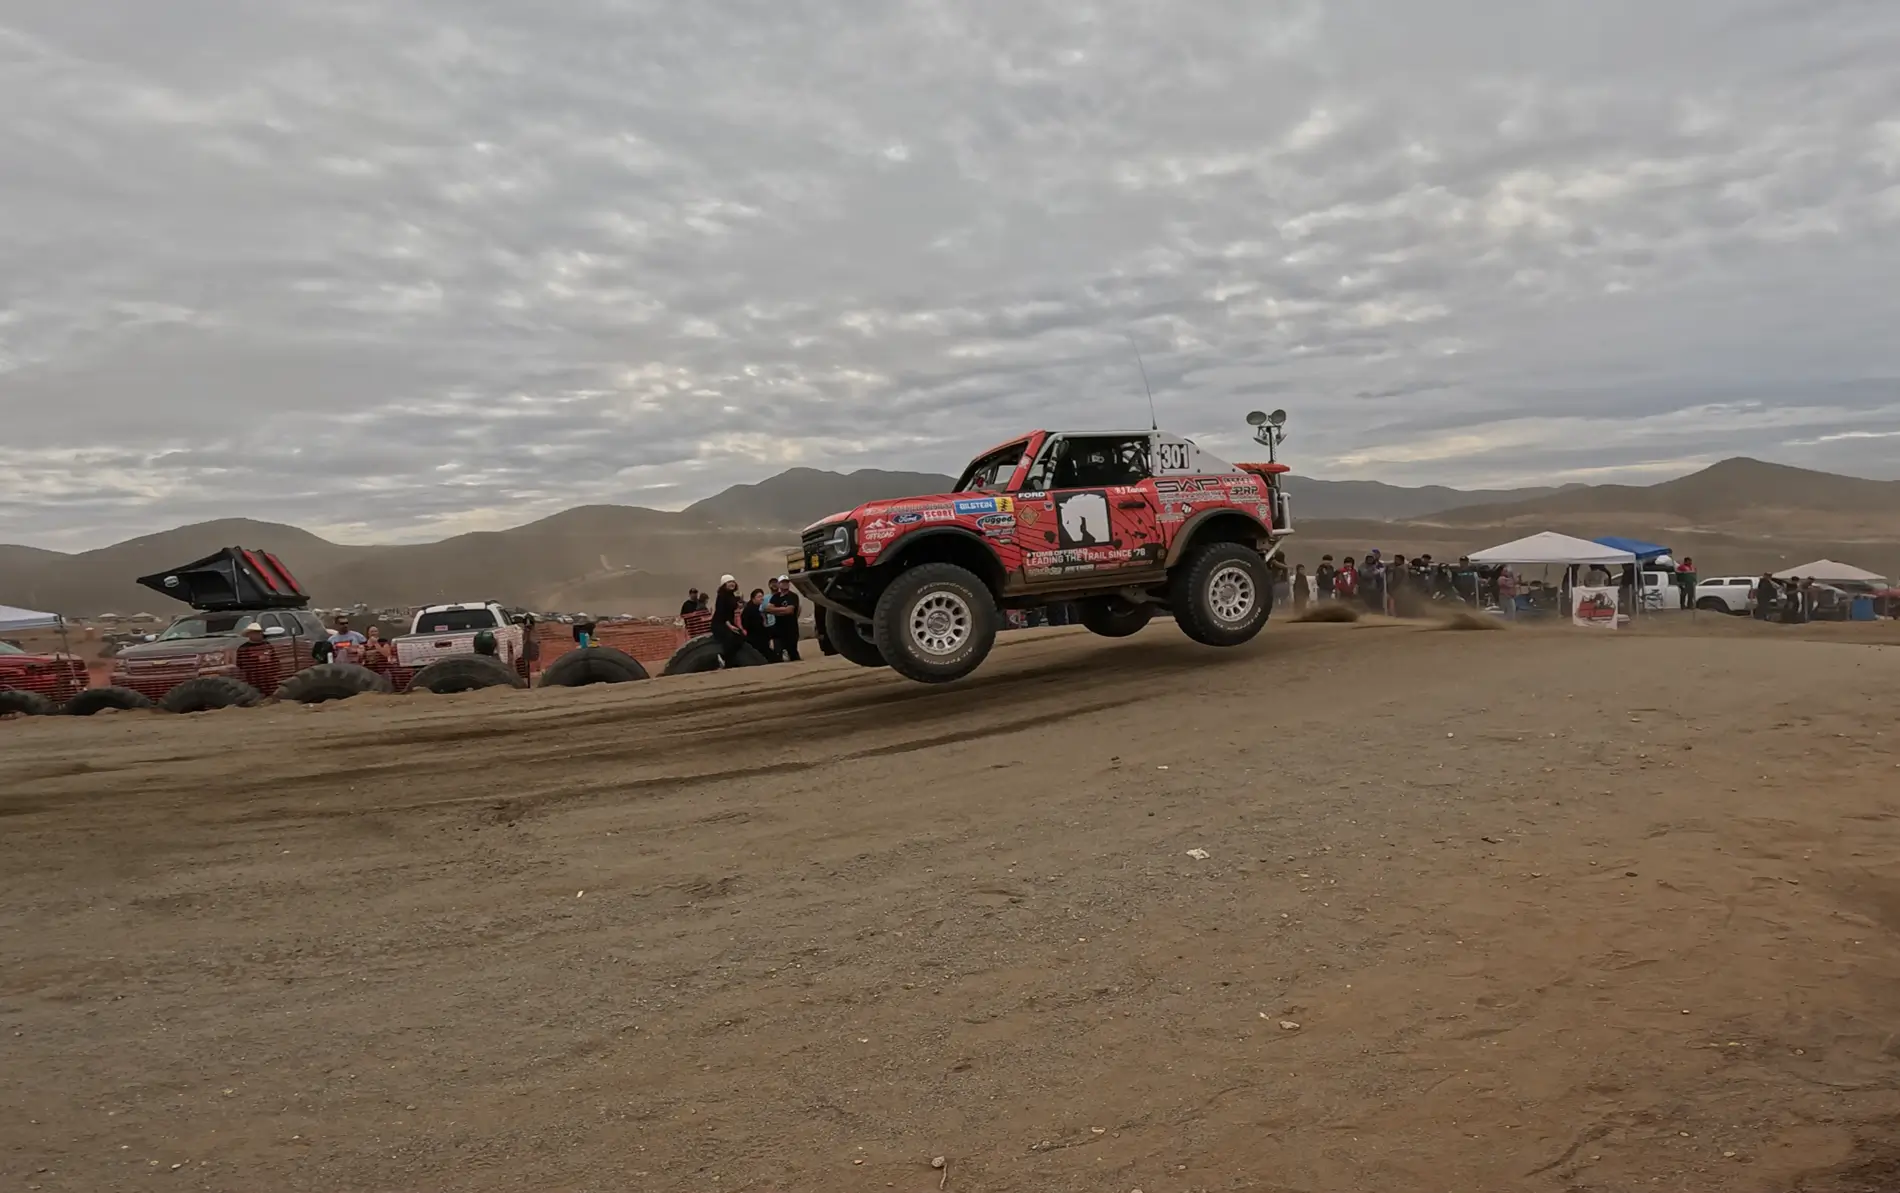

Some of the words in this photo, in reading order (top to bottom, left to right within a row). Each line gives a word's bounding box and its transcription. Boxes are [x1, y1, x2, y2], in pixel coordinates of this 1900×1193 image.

[1161, 444, 1189, 469] 301
[1018, 491, 1046, 499] FORD
[960, 501, 993, 510] BILSTEIN
[926, 510, 954, 518] SCORE
[866, 532, 895, 540] OFFROAD
[1026, 555, 1064, 567] LEADING
[1066, 554, 1083, 562] THE
[1084, 551, 1107, 562] TRAIL
[1108, 550, 1132, 560] SINCE
